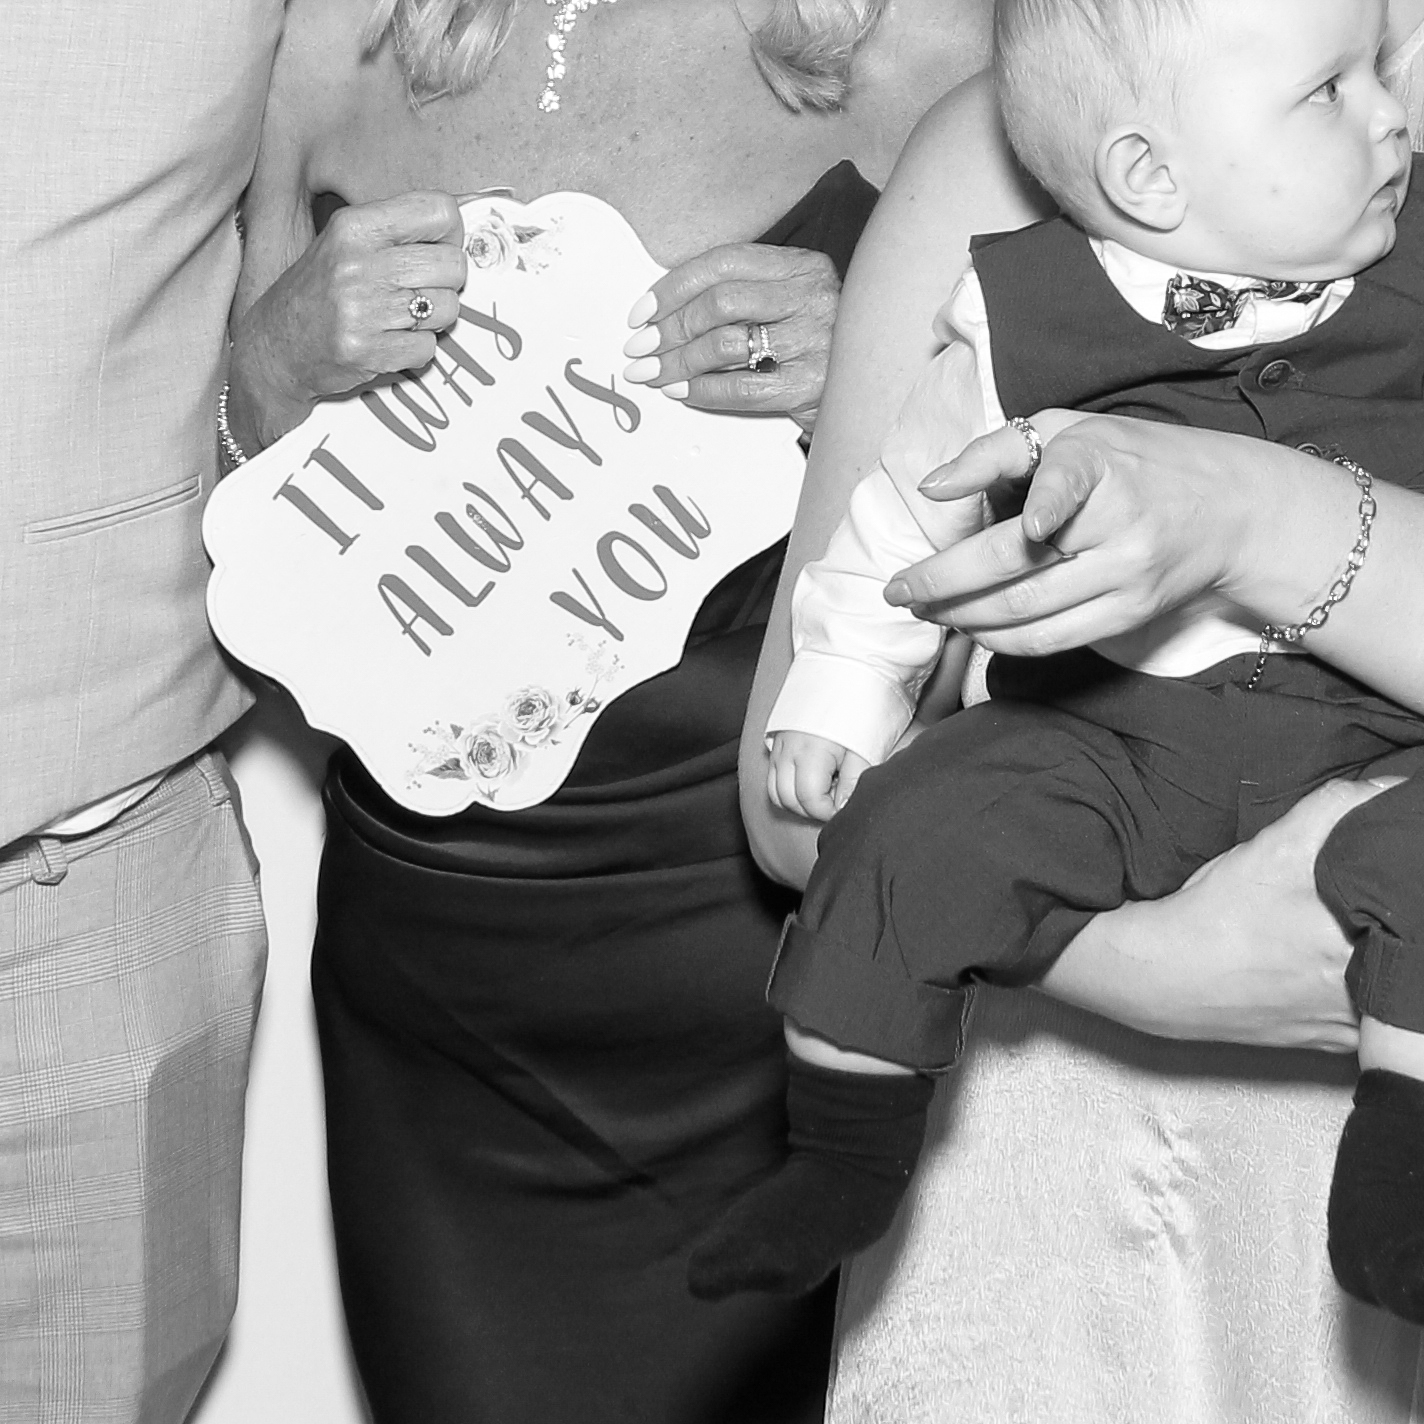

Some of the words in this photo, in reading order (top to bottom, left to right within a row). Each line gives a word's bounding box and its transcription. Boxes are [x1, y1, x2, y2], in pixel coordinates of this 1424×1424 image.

[272, 433, 385, 555] IT
[360, 300, 523, 452] WAS
[377, 357, 641, 657] ALWAYS
[549, 484, 712, 642] YOU
